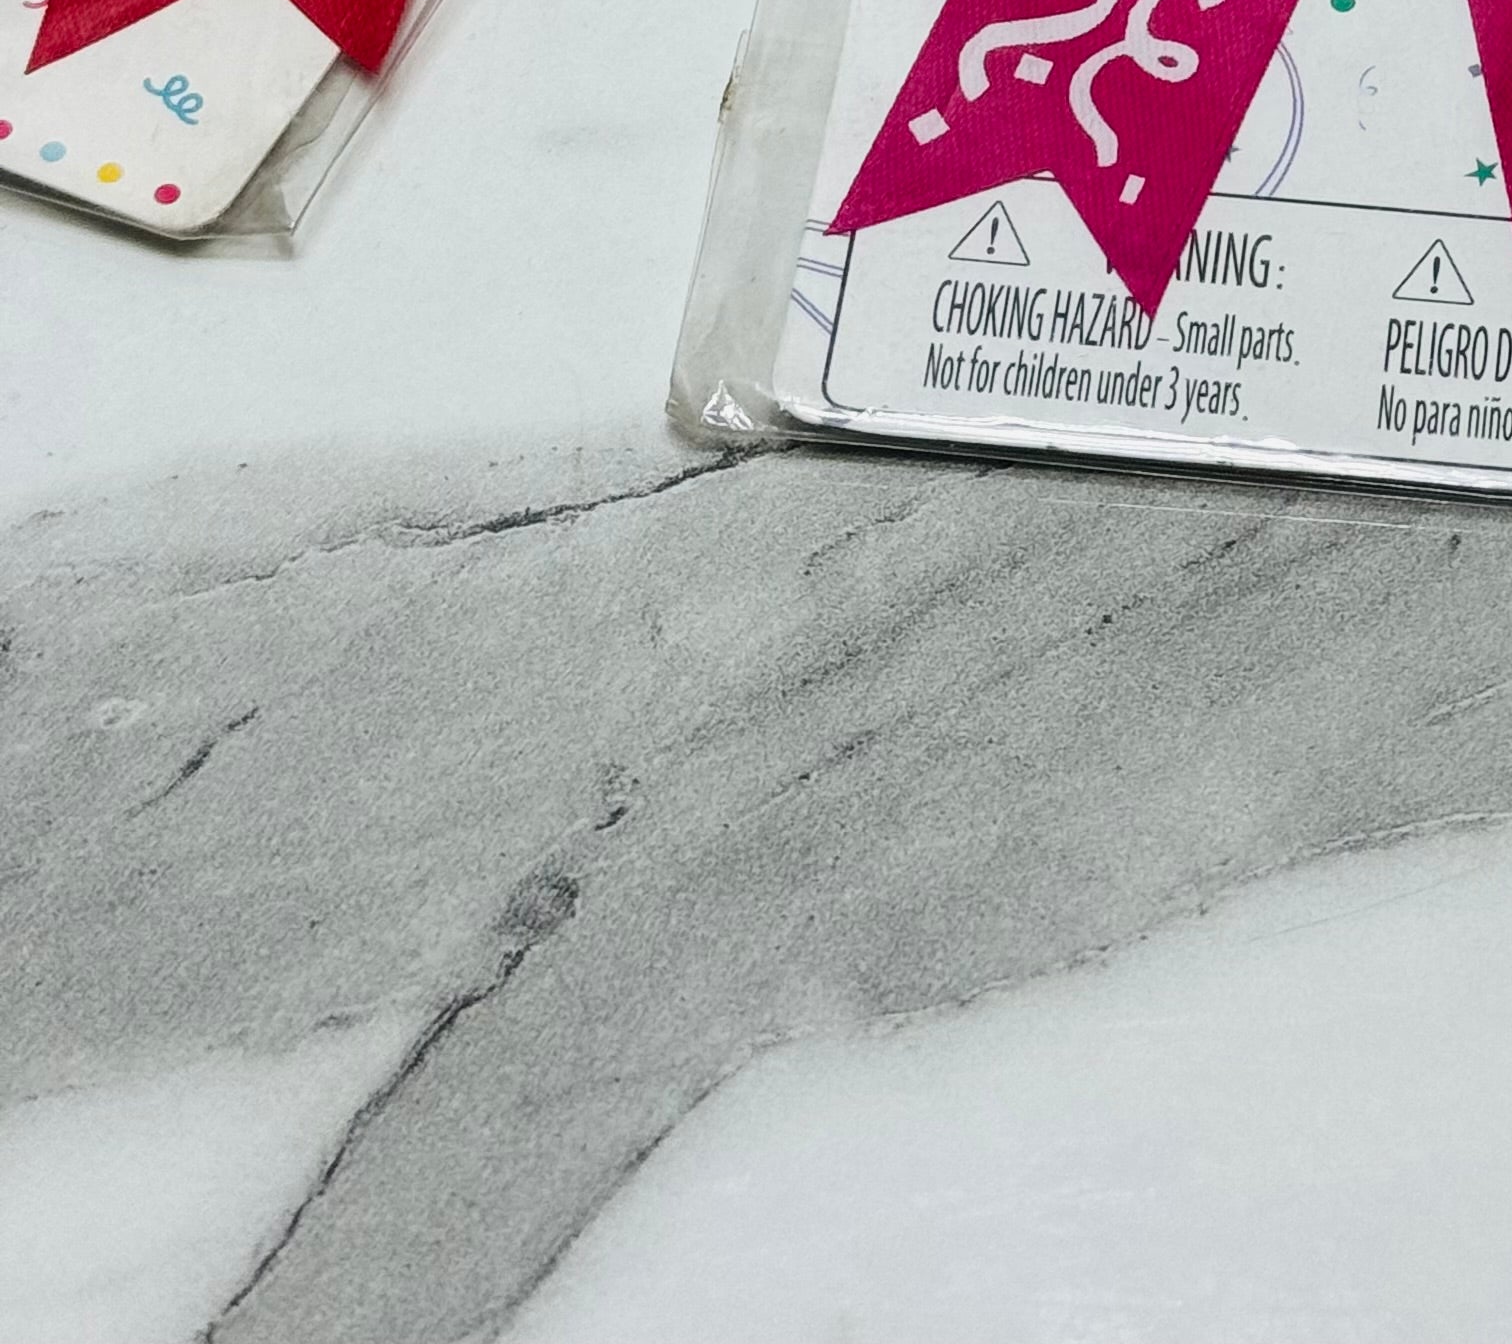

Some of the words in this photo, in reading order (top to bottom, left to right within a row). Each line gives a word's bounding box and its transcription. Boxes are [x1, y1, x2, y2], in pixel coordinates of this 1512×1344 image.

[1106, 228, 1286, 291] NING:
[931, 279, 1047, 342] CHOKING
[1049, 289, 1153, 351] HAZARD
[1172, 311, 1236, 358] Small
[1236, 324, 1300, 370] parts.
[1383, 318, 1489, 383] PELIGRO
[922, 343, 965, 392] Not
[966, 345, 1002, 395] for
[1003, 350, 1092, 404] children
[1096, 360, 1163, 409] under
[1163, 366, 1181, 411] 3
[1180, 376, 1249, 424] years.
[1377, 383, 1408, 433] No
[1411, 398, 1461, 445] para
